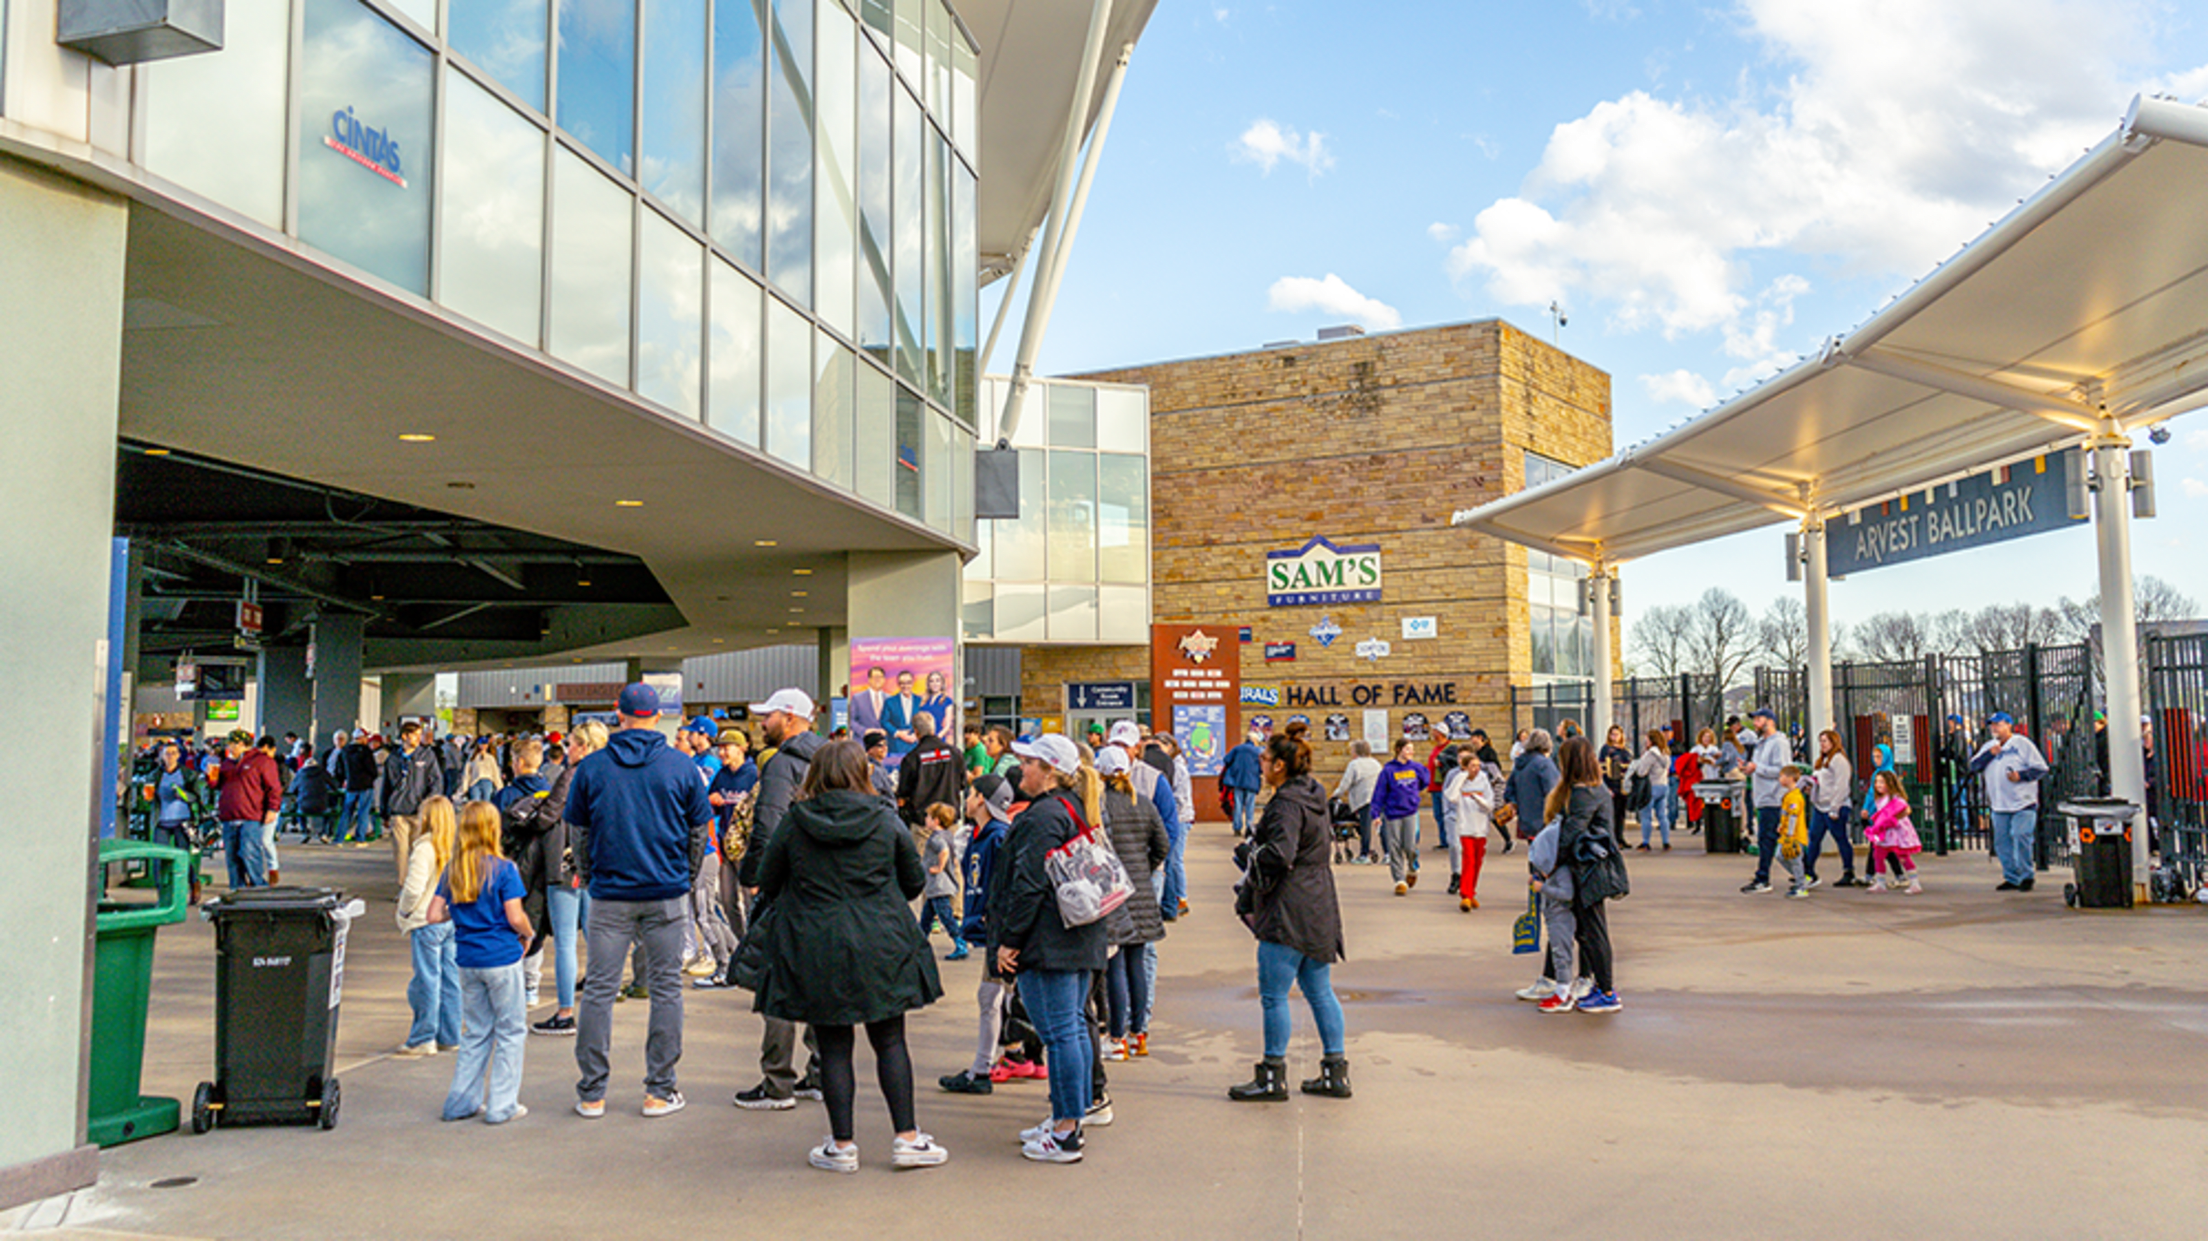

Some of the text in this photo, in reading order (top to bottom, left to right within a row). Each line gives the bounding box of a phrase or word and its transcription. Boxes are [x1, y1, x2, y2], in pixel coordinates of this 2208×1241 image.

[1855, 486, 2034, 563] ARVEST BALLPARK
[1271, 556, 1377, 590] SAM'S
[1275, 591, 1374, 604] FURNITURE
[1287, 683, 1457, 705] HALL OF FAME
